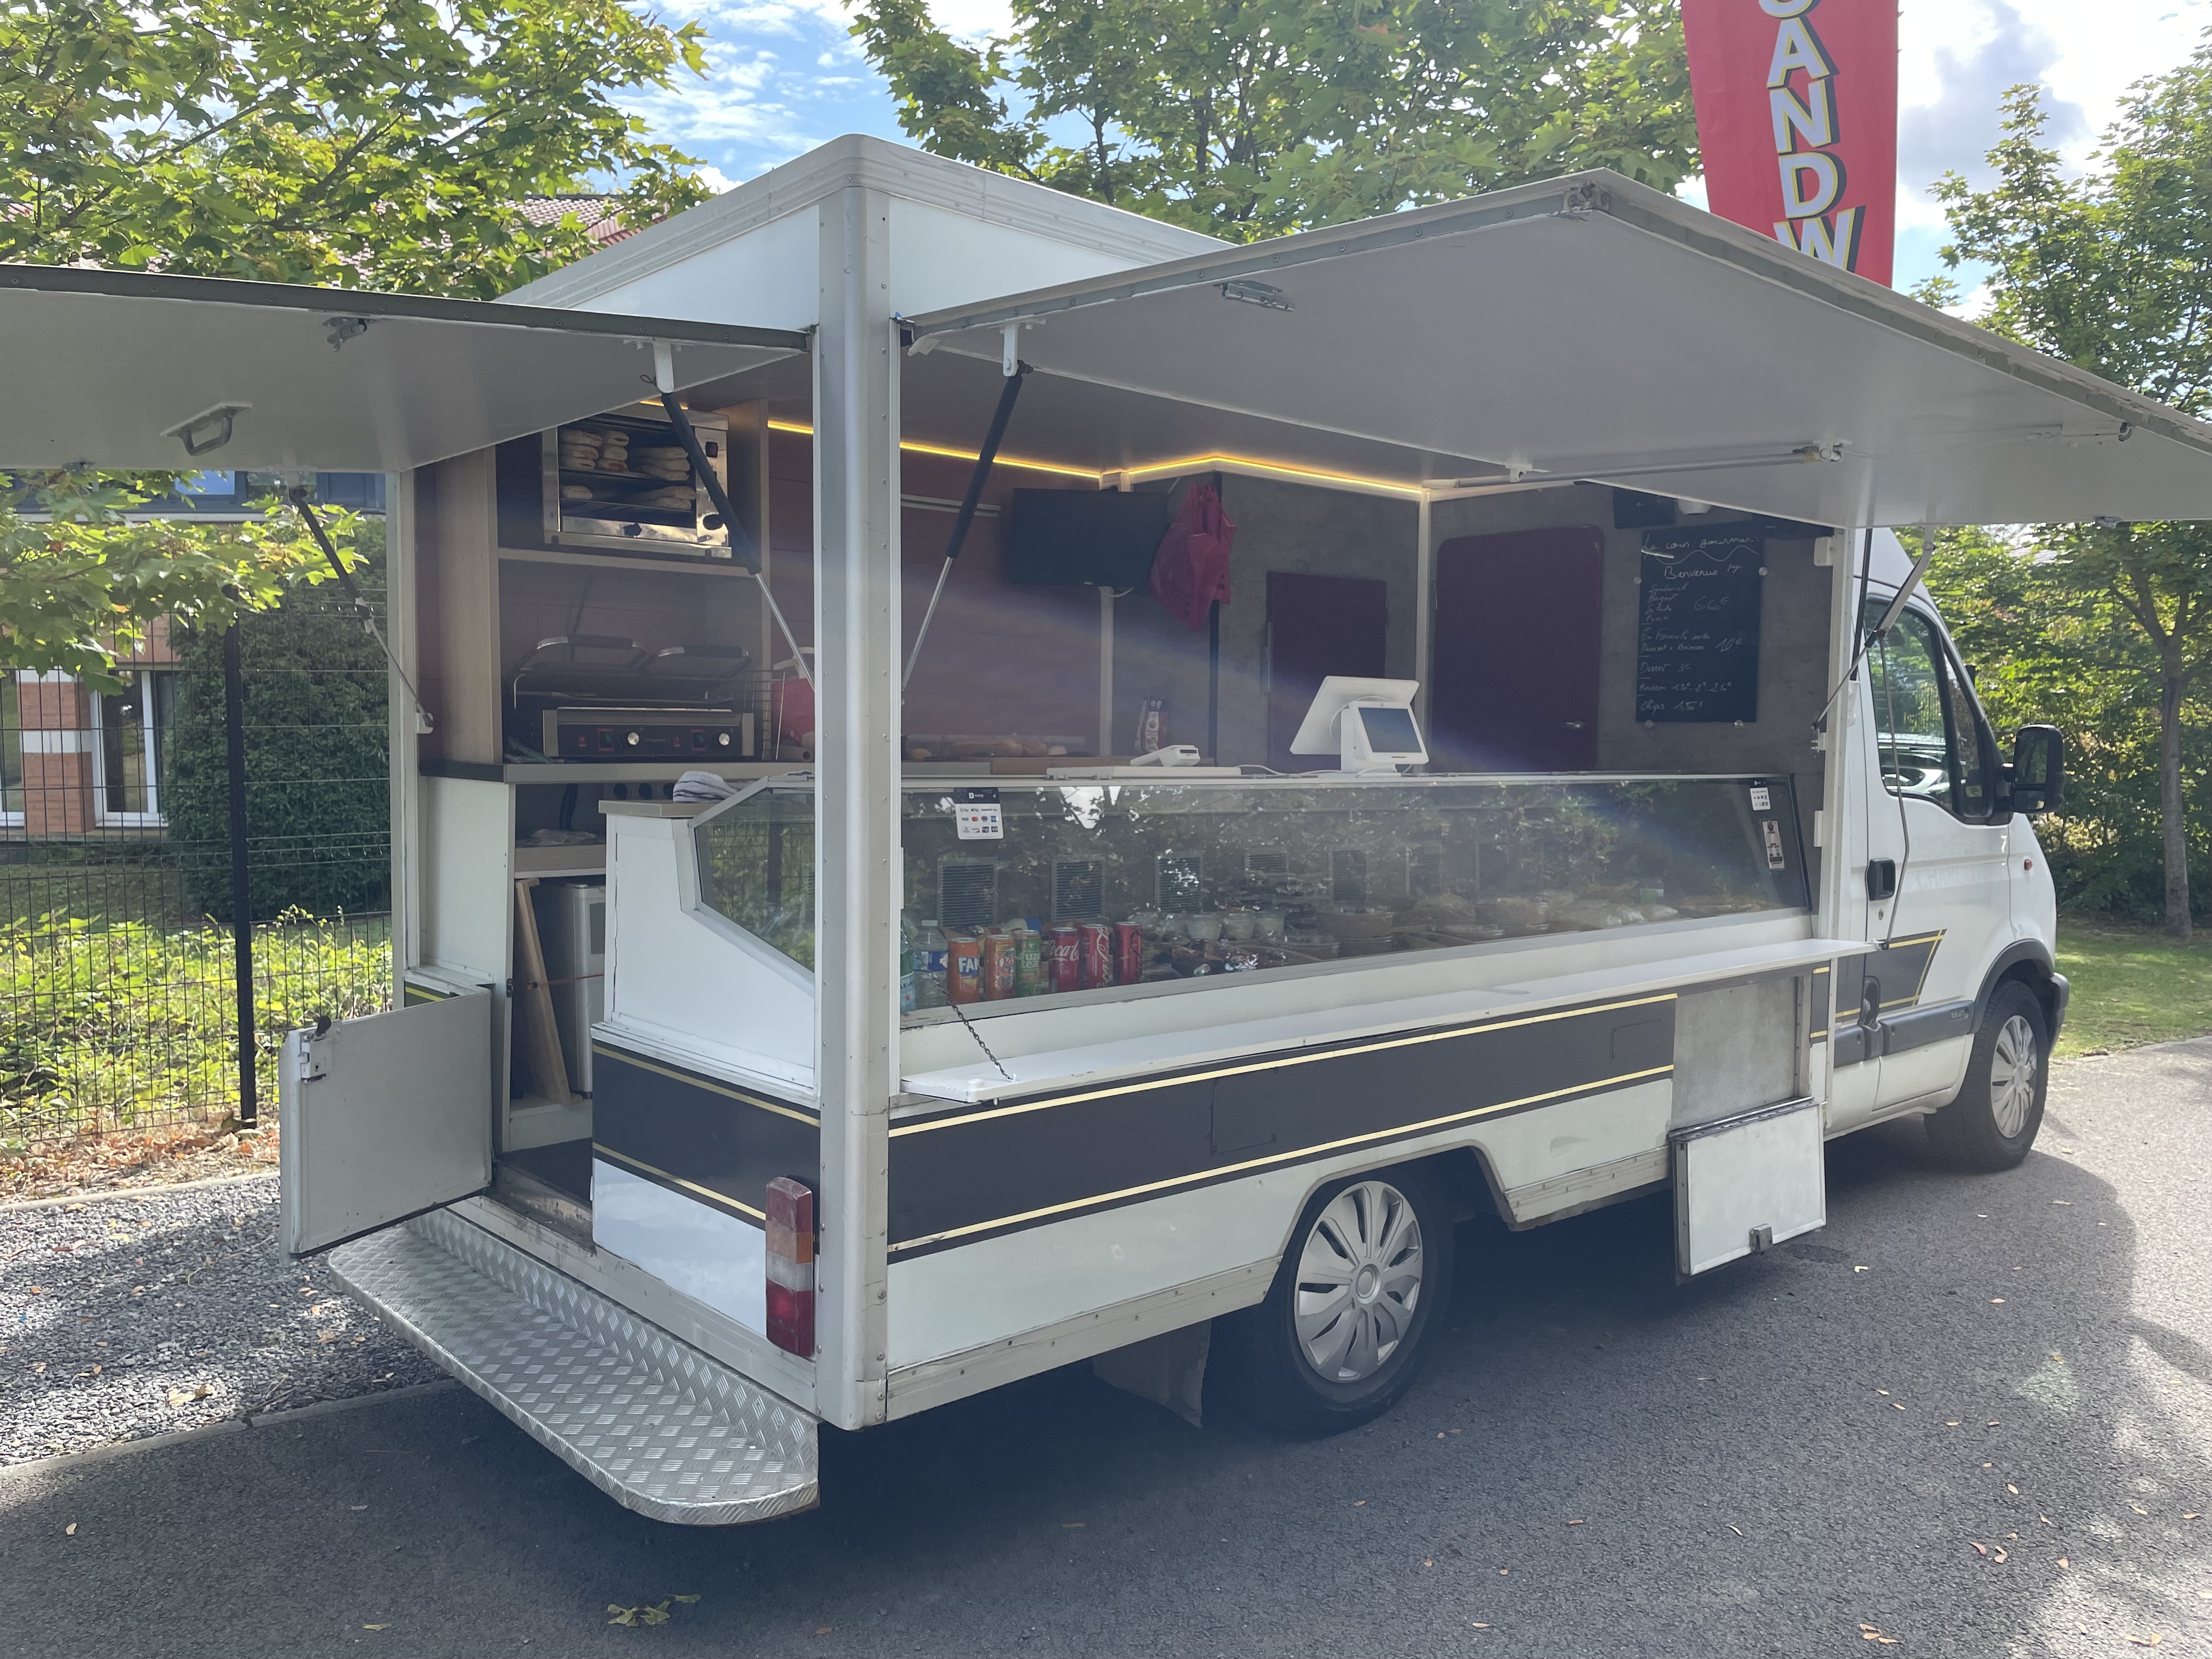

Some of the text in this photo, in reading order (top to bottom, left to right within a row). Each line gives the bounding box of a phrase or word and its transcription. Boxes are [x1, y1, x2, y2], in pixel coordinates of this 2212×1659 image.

[1759, 0, 1866, 273] ANDW
[1666, 540, 1690, 549] coin
[1664, 566, 1718, 579] Bienvenue
[1640, 699, 1665, 716] Chips
